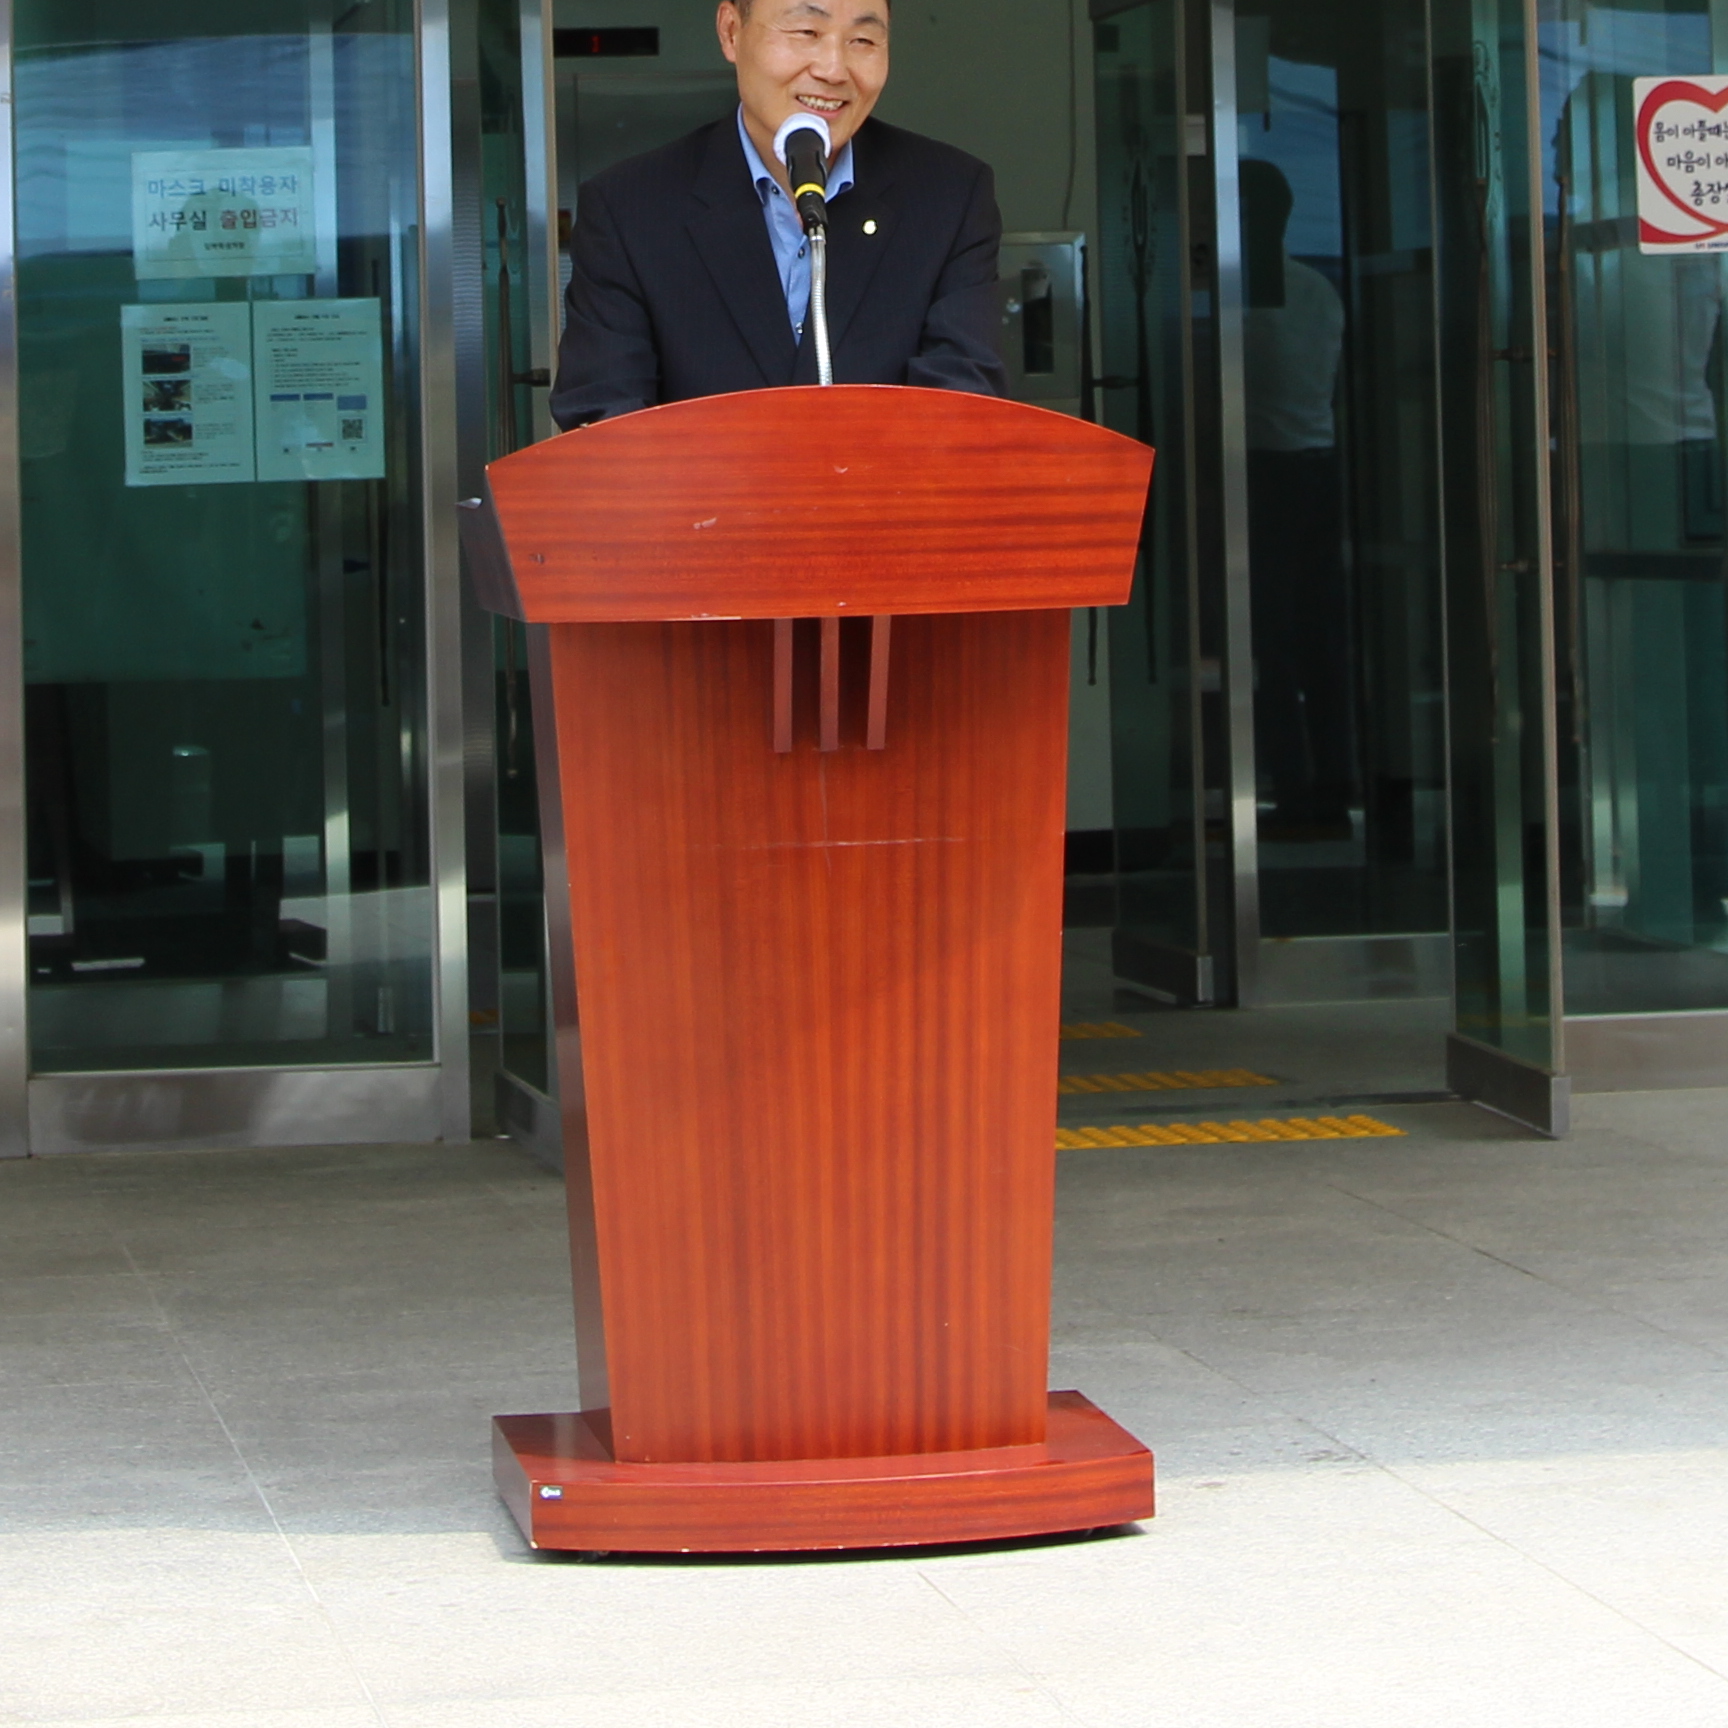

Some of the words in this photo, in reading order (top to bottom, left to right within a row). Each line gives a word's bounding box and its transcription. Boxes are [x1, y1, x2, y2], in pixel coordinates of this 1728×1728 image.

[1654, 121, 1679, 143] 몸이
[1667, 150, 1711, 173] 마음이
[148, 178, 207, 198] 마스크
[218, 174, 298, 197] 미착용자
[148, 210, 207, 232] 사무실
[220, 207, 298, 231] 출입금지
